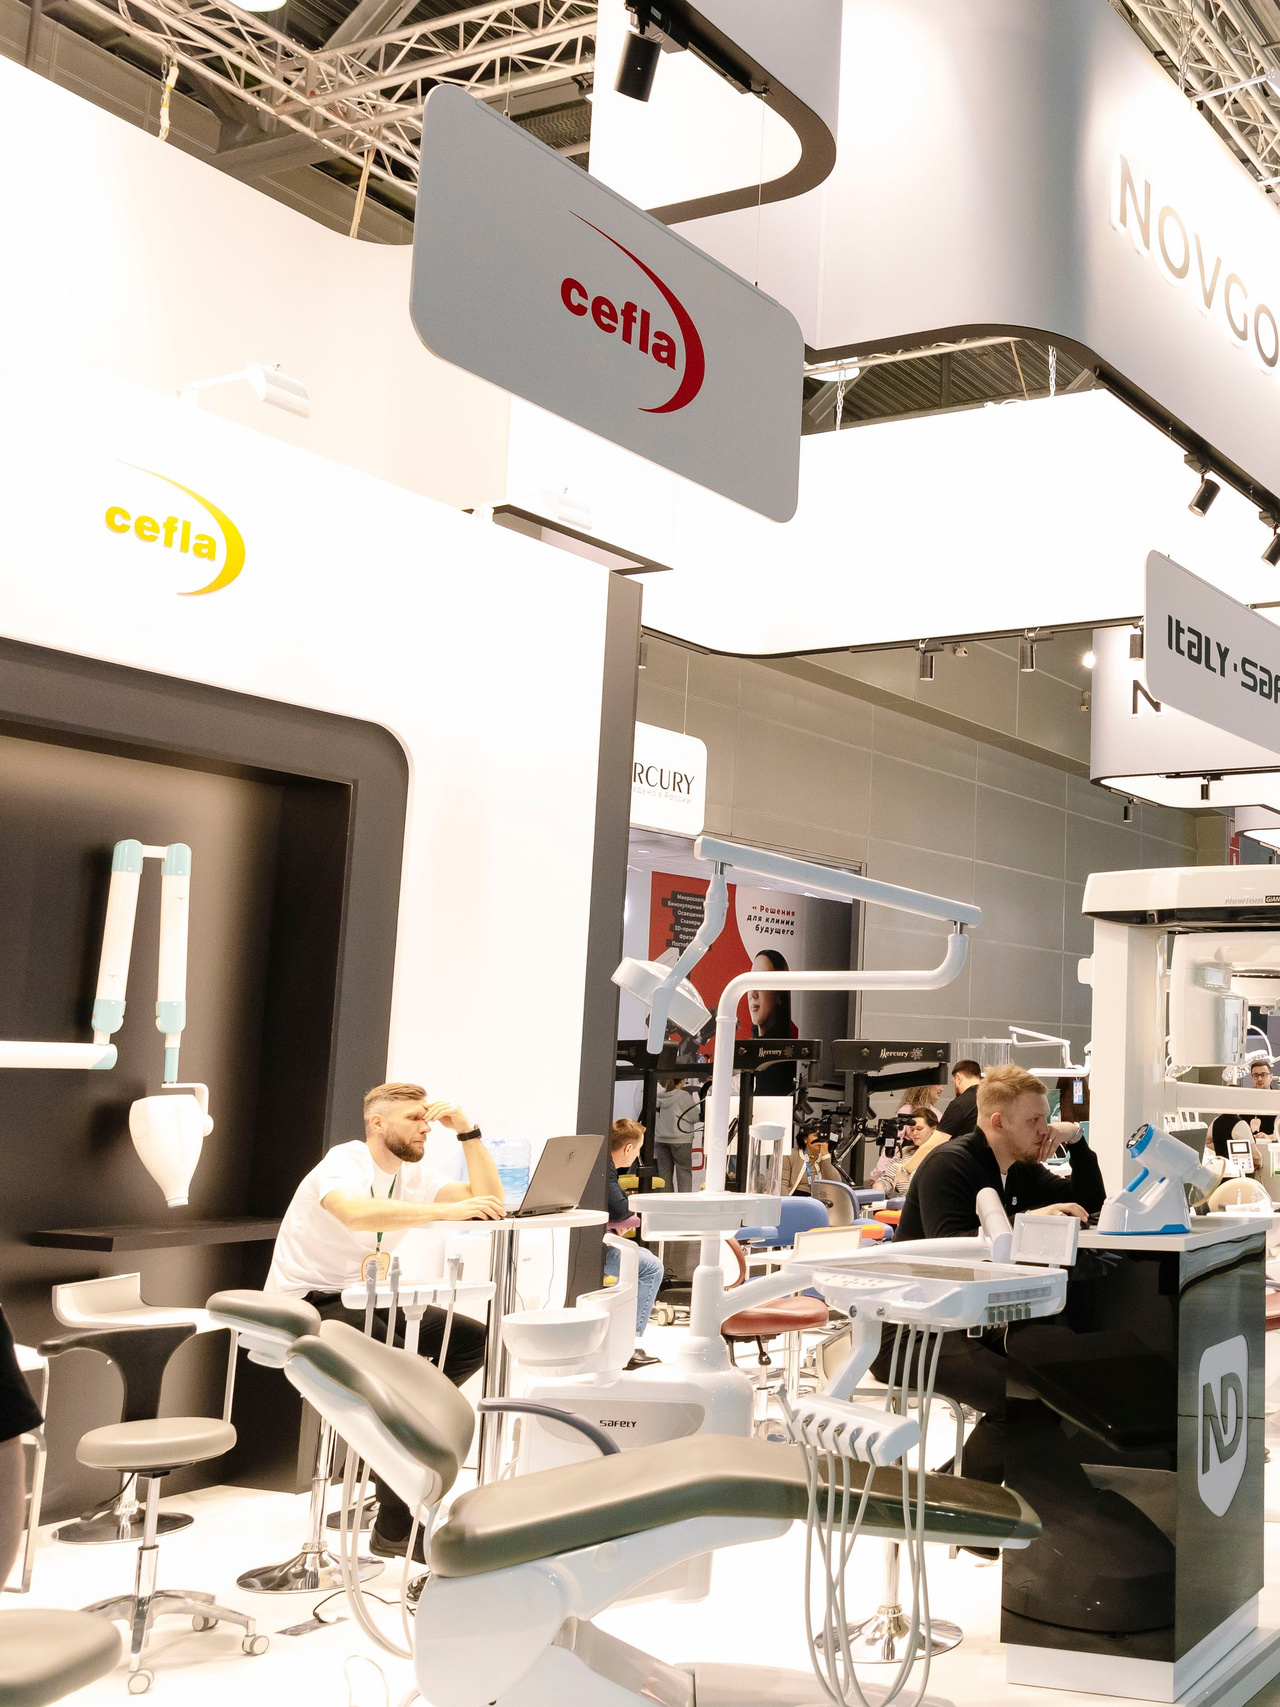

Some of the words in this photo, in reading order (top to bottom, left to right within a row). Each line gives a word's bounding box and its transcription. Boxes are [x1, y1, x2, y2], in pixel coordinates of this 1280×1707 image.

[561, 277, 677, 371] cefla
[105, 506, 217, 562] cefla
[633, 761, 695, 795] RCURY
[747, 914, 762, 922] для
[765, 917, 795, 926] клиник
[755, 924, 795, 936] будущего
[879, 1048, 909, 1059] Mercury
